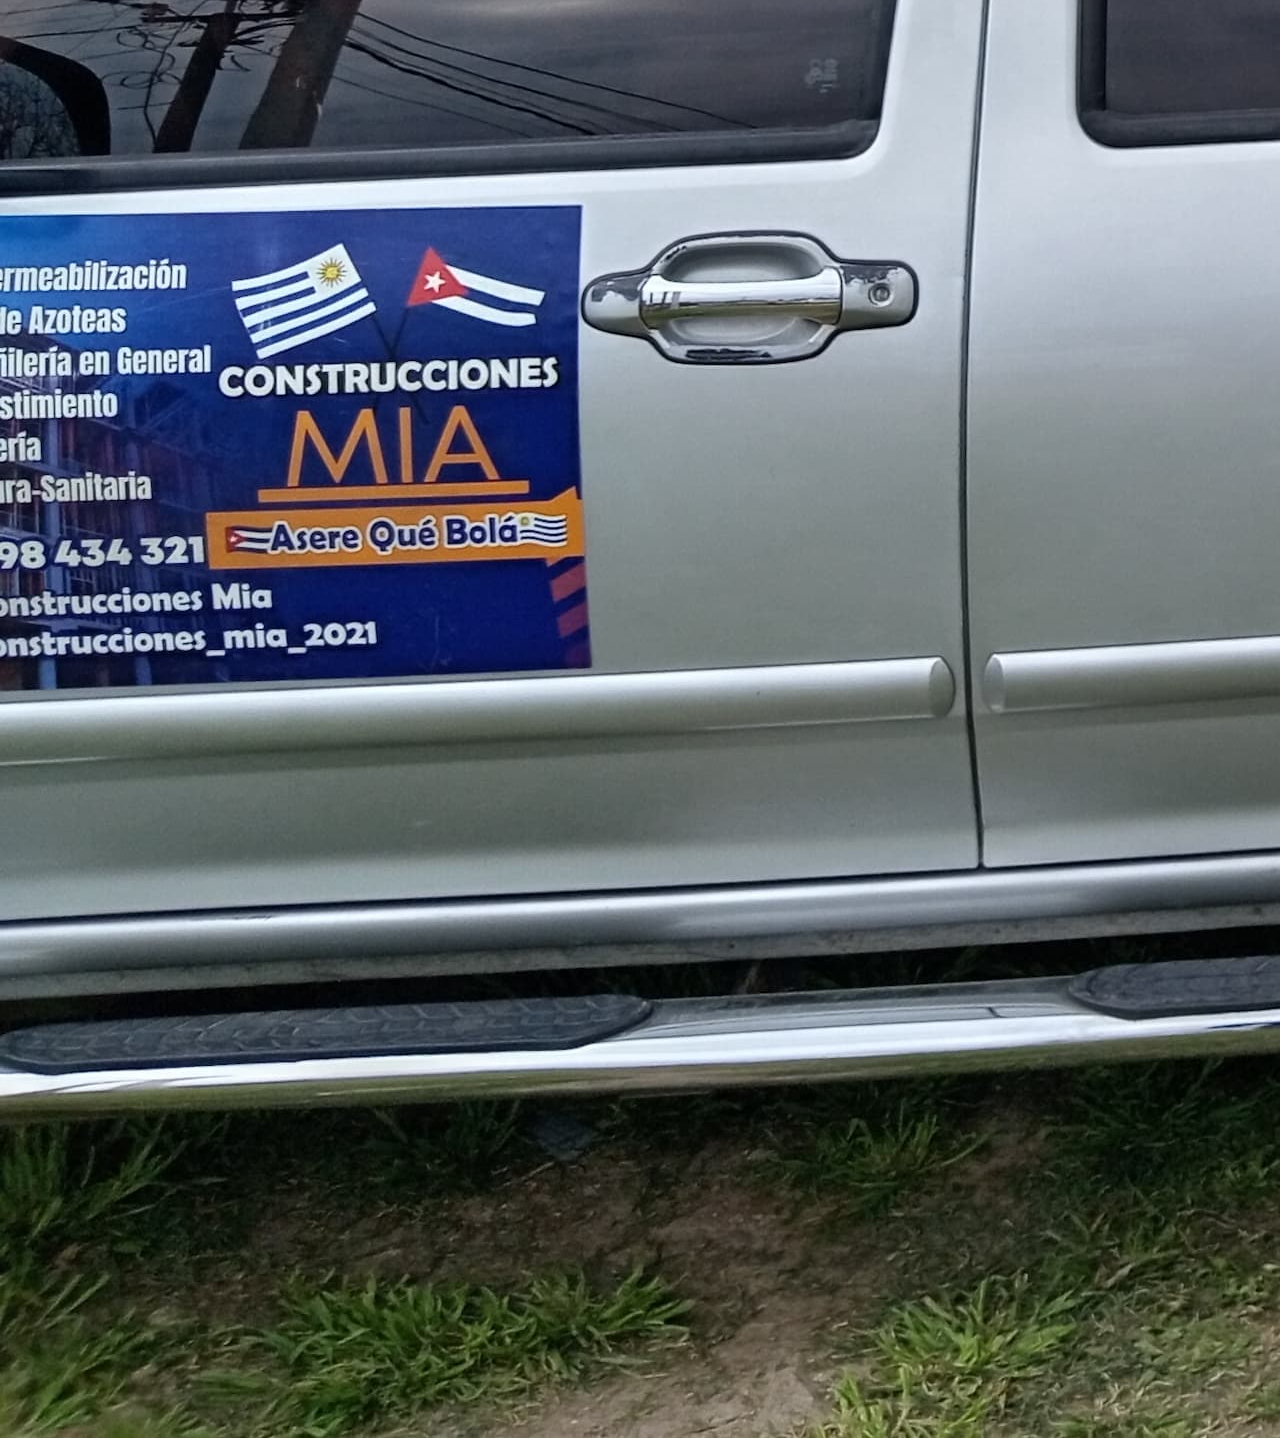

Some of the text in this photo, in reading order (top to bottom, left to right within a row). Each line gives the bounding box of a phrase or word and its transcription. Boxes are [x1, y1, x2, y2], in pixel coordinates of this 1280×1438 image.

[0, 258, 188, 292] rmeabilización
[28, 305, 127, 335] Azoteas
[79, 349, 110, 376] en
[117, 345, 212, 375] General
[218, 356, 559, 398] CONSTRUCCIONES
[0, 388, 118, 420] stimiento
[287, 405, 500, 487] MIA
[268, 512, 520, 554] Asere Qué Bolá
[0, 535, 205, 570] 98 434 321
[211, 582, 273, 610] Mia
